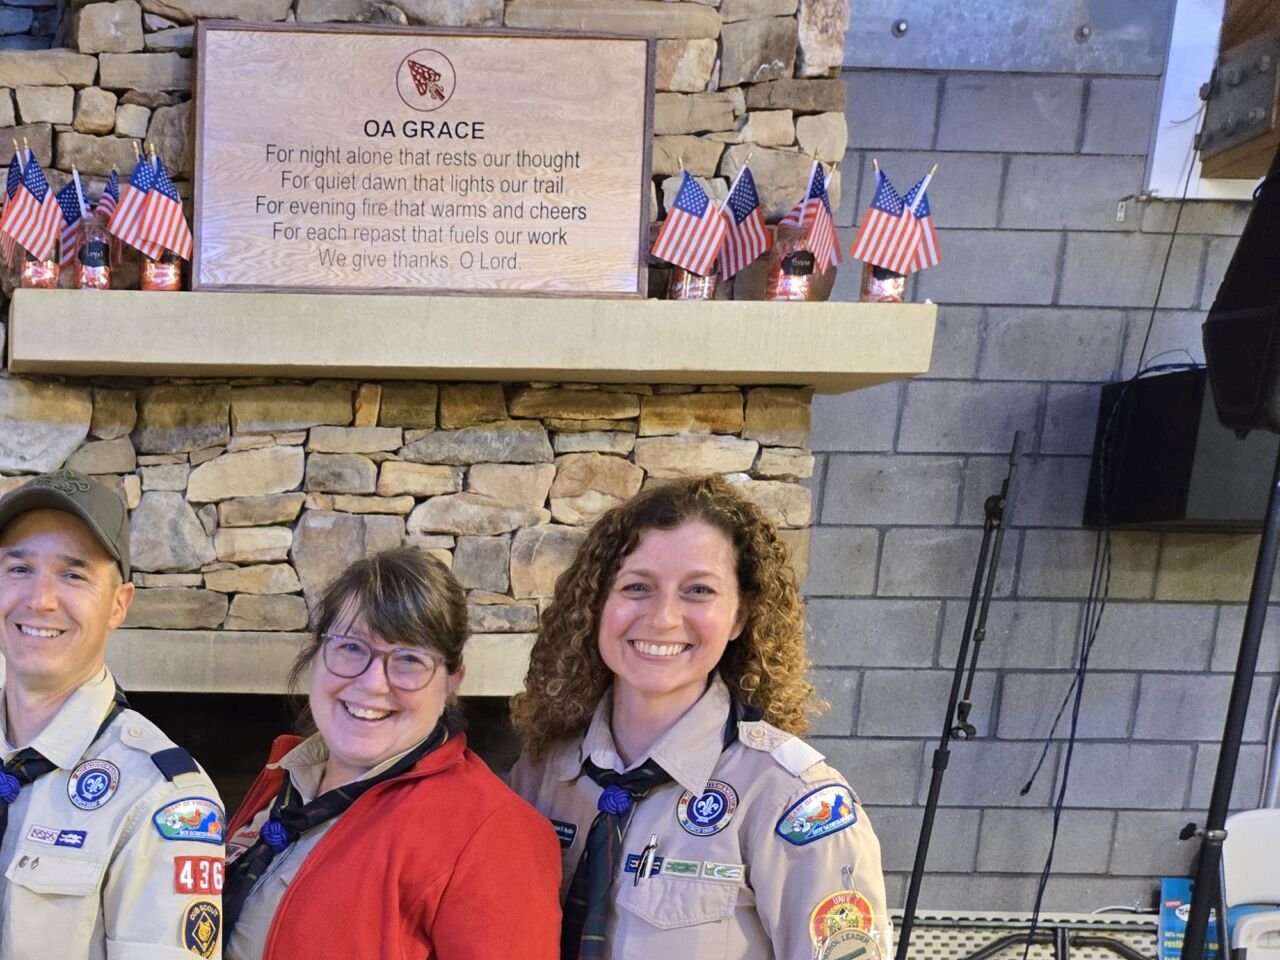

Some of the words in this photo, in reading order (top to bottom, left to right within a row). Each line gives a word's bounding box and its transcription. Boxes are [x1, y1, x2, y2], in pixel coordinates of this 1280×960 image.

[363, 119, 396, 138] OA
[402, 120, 485, 140] GRACE
[265, 144, 294, 163] For
[299, 146, 341, 168] night
[346, 147, 393, 165] alone
[399, 147, 430, 166] that
[436, 150, 477, 167] rests
[482, 152, 511, 167] our
[516, 150, 580, 173] thought
[281, 170, 309, 189] For
[315, 172, 356, 193] quiet
[361, 173, 407, 190] dawn
[413, 174, 444, 192] that
[450, 175, 494, 196] lights
[500, 178, 528, 193] our
[533, 176, 564, 193] trail
[256, 195, 283, 214] For
[289, 198, 356, 220] evening
[362, 198, 388, 217] fire
[394, 199, 425, 217] that
[431, 203, 487, 219] warms
[492, 201, 524, 219] and
[530, 201, 587, 220] cheers
[273, 222, 301, 240] For
[306, 224, 347, 241] each
[353, 225, 406, 245] repast
[412, 226, 442, 243] that
[449, 225, 489, 244] fuels
[494, 230, 522, 245] our
[528, 227, 568, 246] work
[318, 248, 346, 267] We
[352, 250, 387, 272] give
[393, 250, 453, 270] thanks,
[480, 251, 522, 271] Lord.
[179, 860, 224, 890] 436
[199, 904, 219, 917] SCOUT
[841, 933, 870, 945] LEADER
